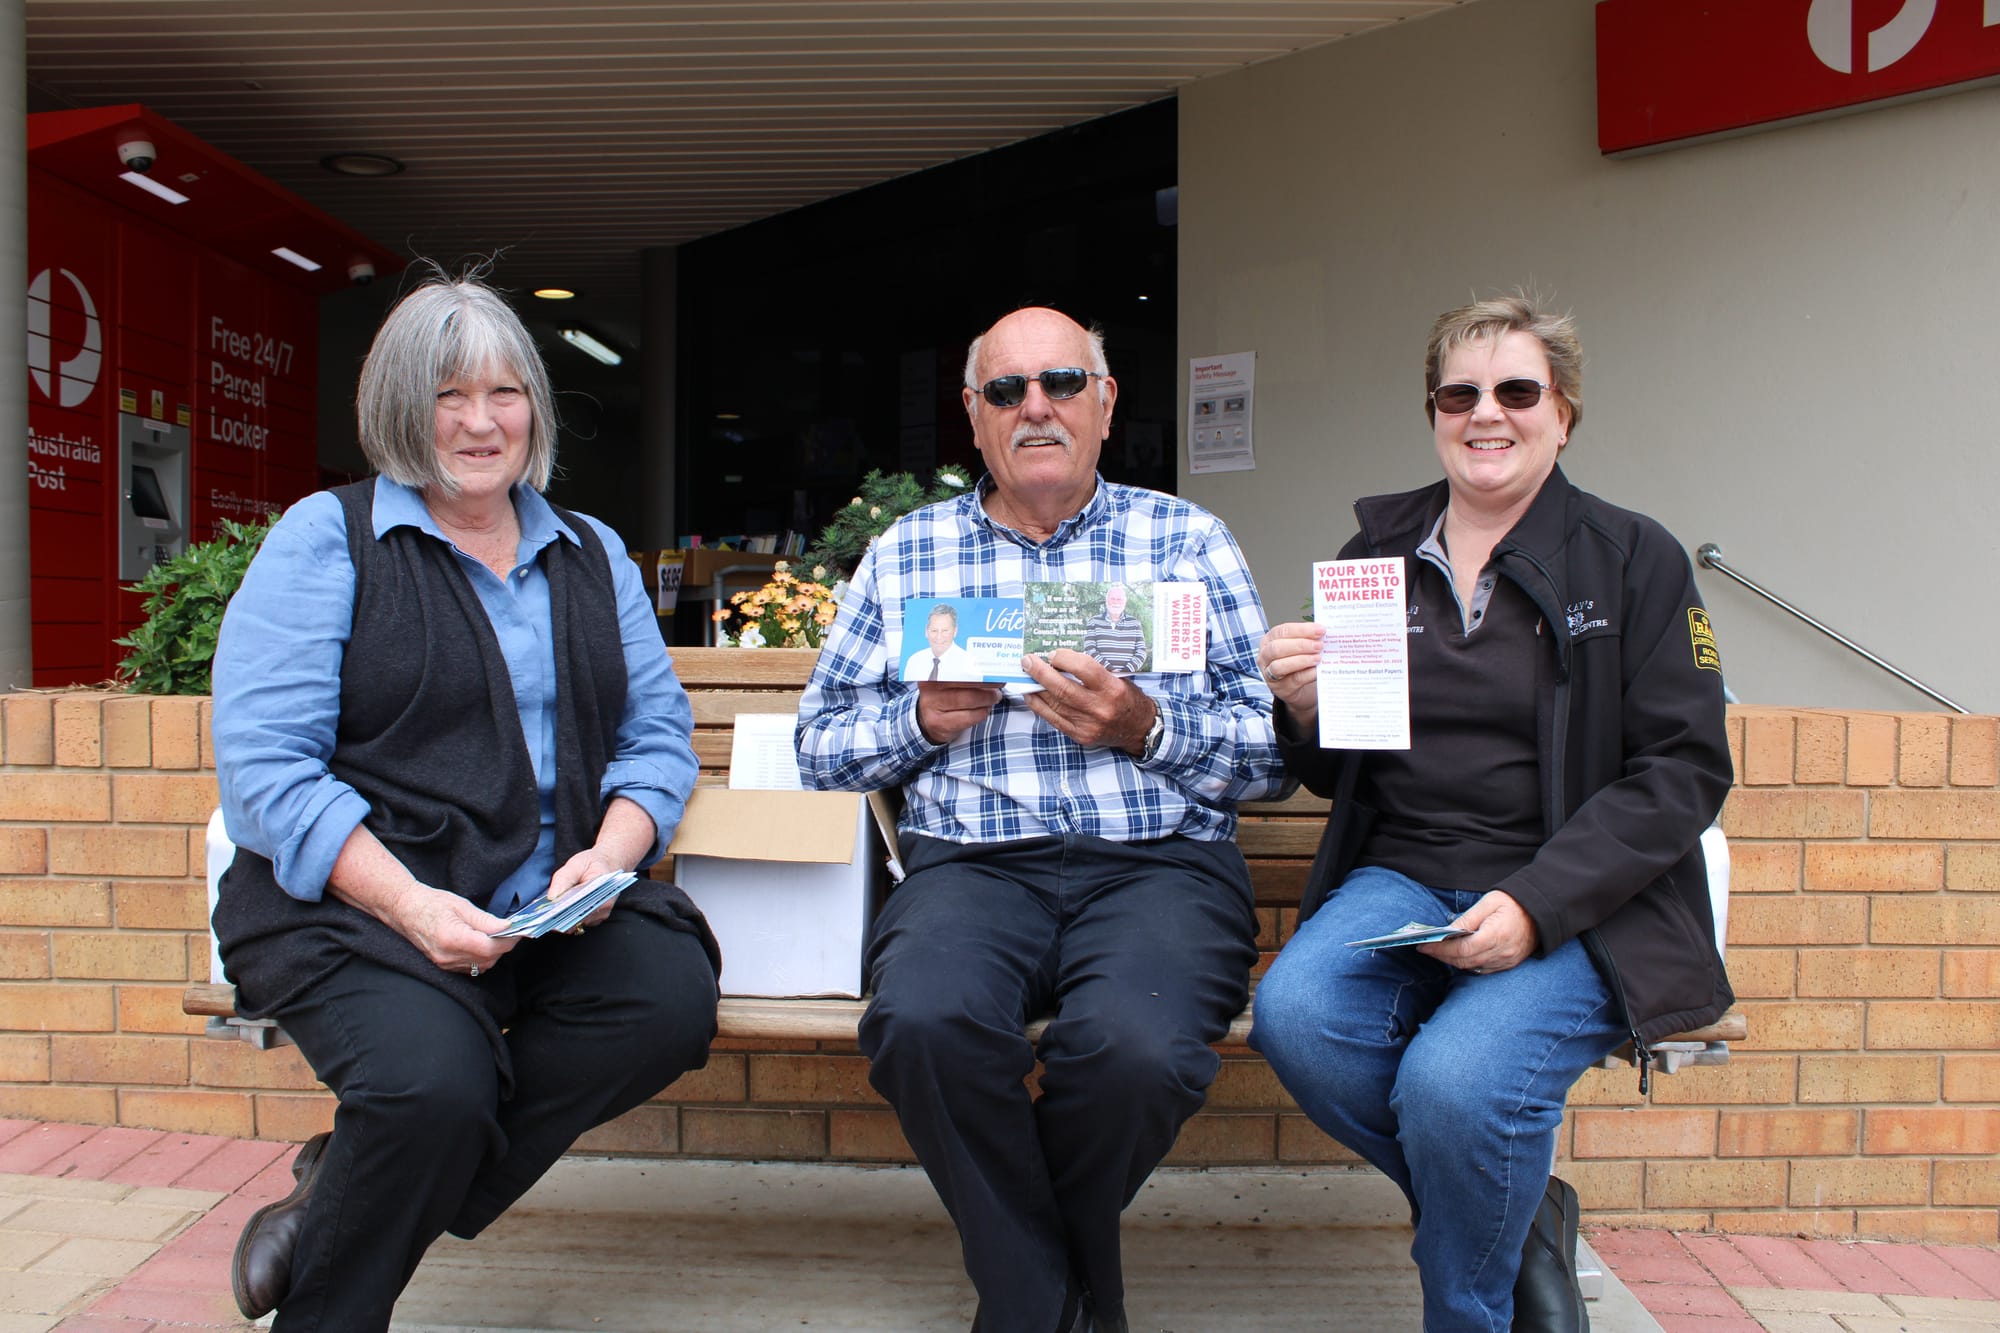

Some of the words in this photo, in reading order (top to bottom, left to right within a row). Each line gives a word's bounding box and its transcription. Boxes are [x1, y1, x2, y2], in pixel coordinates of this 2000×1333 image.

[211, 315, 251, 361] Free
[254, 332, 294, 376] 24/7
[1195, 363, 1223, 373] Important
[211, 361, 267, 409] Parcel
[210, 407, 269, 451] Locker
[28, 427, 101, 463] Australia
[1318, 565, 1356, 578] YOUR
[1361, 563, 1396, 576] VOTE
[1319, 576, 1380, 590] MATTERS
[1384, 576, 1400, 587] TO
[1325, 589, 1395, 602] WAIKERIE
[986, 608, 1025, 632] Vote
[1042, 605, 1057, 613] have
[1181, 593, 1191, 644] MATTERS
[1192, 595, 1201, 625] YOUR
[1170, 599, 1180, 654] WAIKERIE
[1579, 618, 1609, 633] CENTRE
[972, 641, 1003, 649] TREVOR
[1181, 646, 1191, 660] TO
[1192, 628, 1201, 656] VOTE
